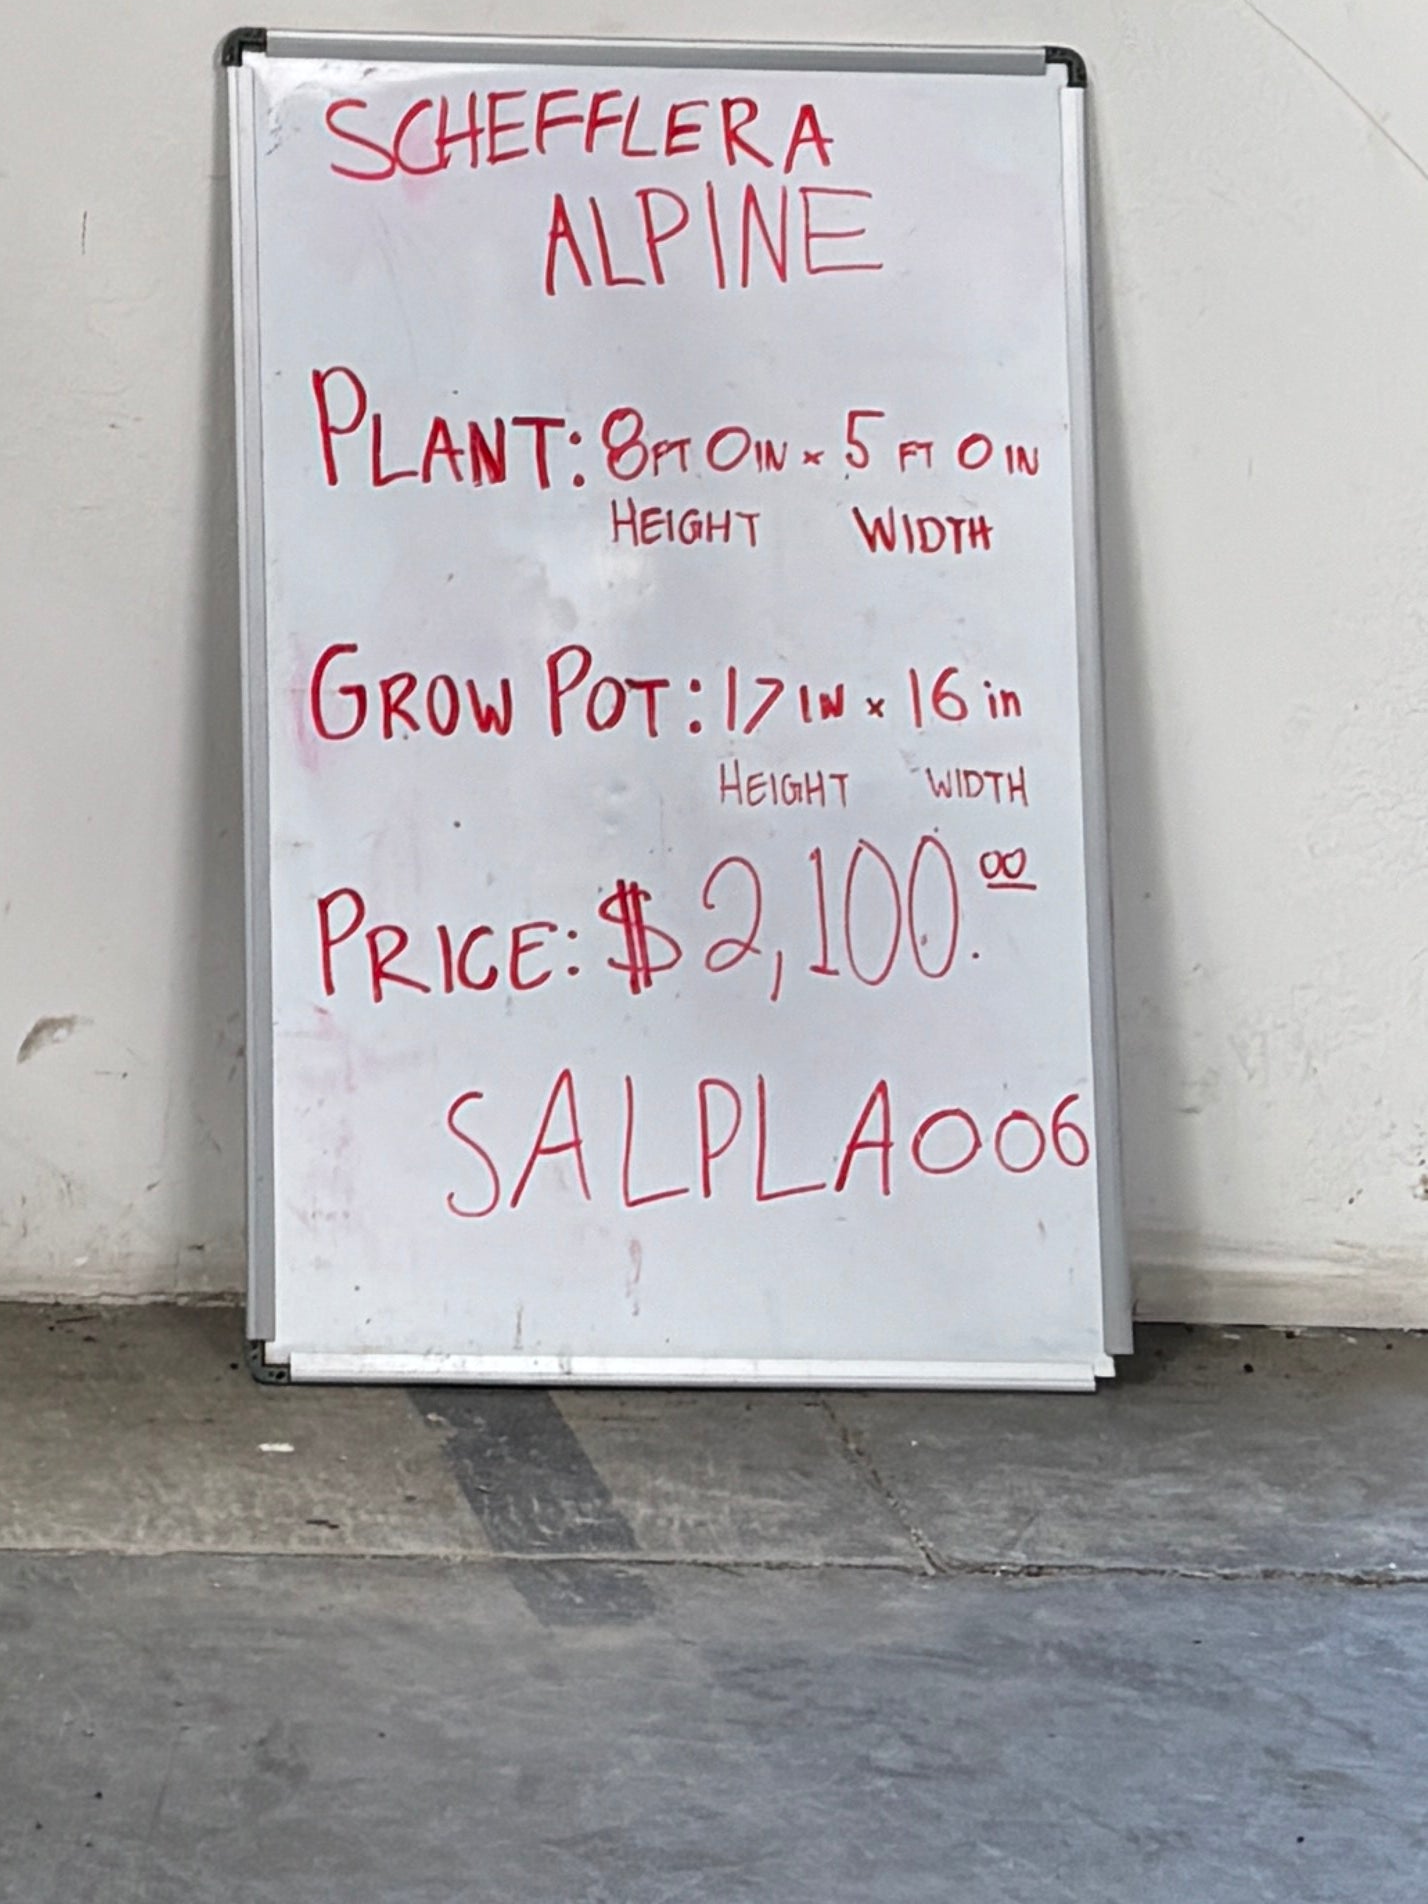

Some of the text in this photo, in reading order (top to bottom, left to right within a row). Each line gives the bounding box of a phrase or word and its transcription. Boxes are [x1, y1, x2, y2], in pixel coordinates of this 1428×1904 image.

[325, 87, 834, 184] SCHEFFLERA
[543, 182, 883, 297] ALPINE
[309, 367, 586, 491] PLANT:
[610, 496, 995, 556] HEIGHT WIDTH
[308, 643, 515, 743] GROW
[544, 643, 703, 739] POT:
[723, 665, 785, 735] 17
[908, 665, 969, 729] 16
[718, 758, 1030, 807] HEIGHT WIDTH
[316, 887, 583, 1004] PRICE:
[445, 1067, 1093, 1219] SALPLA006
